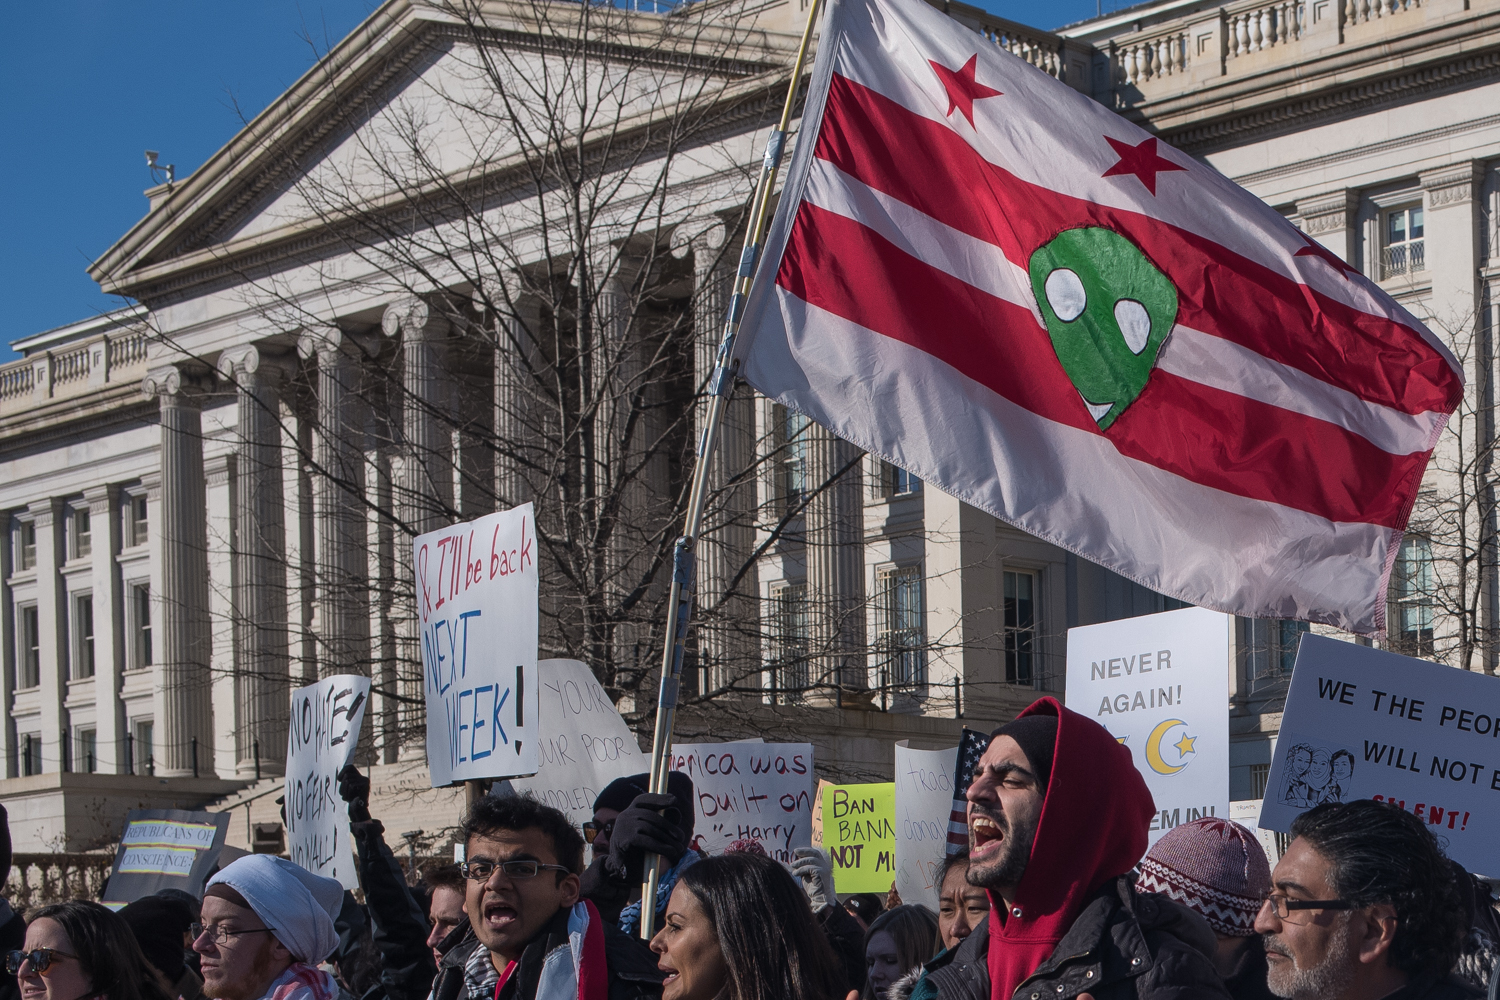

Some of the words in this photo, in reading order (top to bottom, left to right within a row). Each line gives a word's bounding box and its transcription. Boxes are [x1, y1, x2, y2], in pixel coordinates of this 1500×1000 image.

[435, 534, 463, 610] I'll
[465, 530, 482, 591] be
[490, 515, 532, 580] back
[424, 609, 481, 698] NEXT
[1091, 649, 1172, 681] NEVER
[445, 665, 524, 771] WEEK!
[544, 679, 616, 719] YOUR
[1097, 684, 1183, 717] AGAIN!
[1318, 677, 1357, 706] WE
[1372, 689, 1425, 722] THE
[290, 696, 312, 758] NO
[315, 683, 366, 763] HATE!
[581, 733, 632, 763] POOR
[750, 755, 808, 776] was
[1364, 739, 1421, 774] WILL
[1429, 756, 1485, 785] NOT
[288, 778, 304, 833] NO
[697, 783, 769, 818] built
[779, 790, 813, 814] on
[126, 826, 194, 840] REPUBLICANS
[197, 831, 214, 843] OF
[830, 844, 864, 869] NOT
